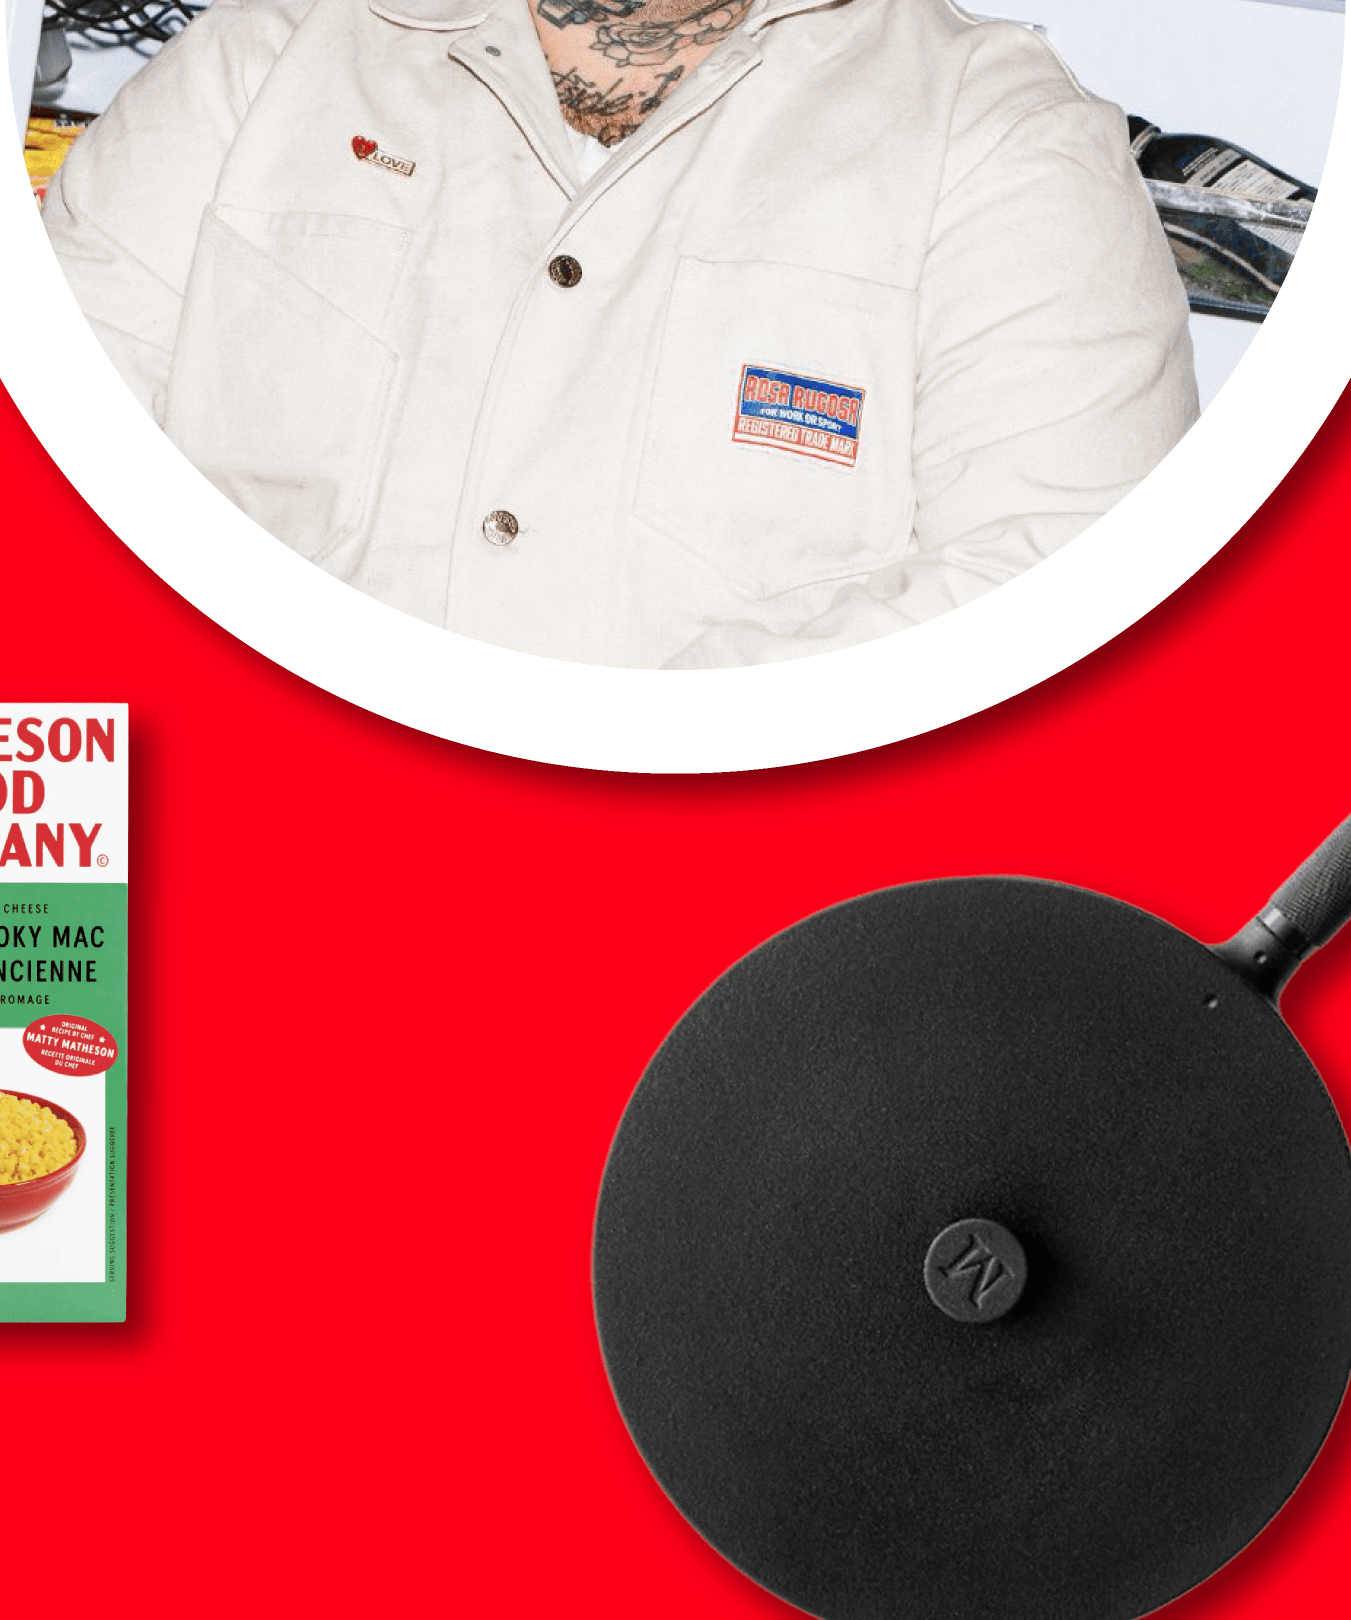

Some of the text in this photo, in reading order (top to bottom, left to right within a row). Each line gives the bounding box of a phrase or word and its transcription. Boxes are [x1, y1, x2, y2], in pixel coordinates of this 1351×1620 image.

[373, 151, 410, 172] LOVE
[744, 374, 860, 426] ROSA RUGOSA
[3, 903, 50, 914] CHEESE
[52, 924, 105, 948] MAC
[52, 1026, 71, 1036] RECIPE
[80, 1032, 96, 1040] CHEF
[62, 1021, 88, 1032] ORIGINAL
[26, 1032, 114, 1058] MATTY MATHESON
[41, 1049, 96, 1066] RECETTE ORIGINALE
